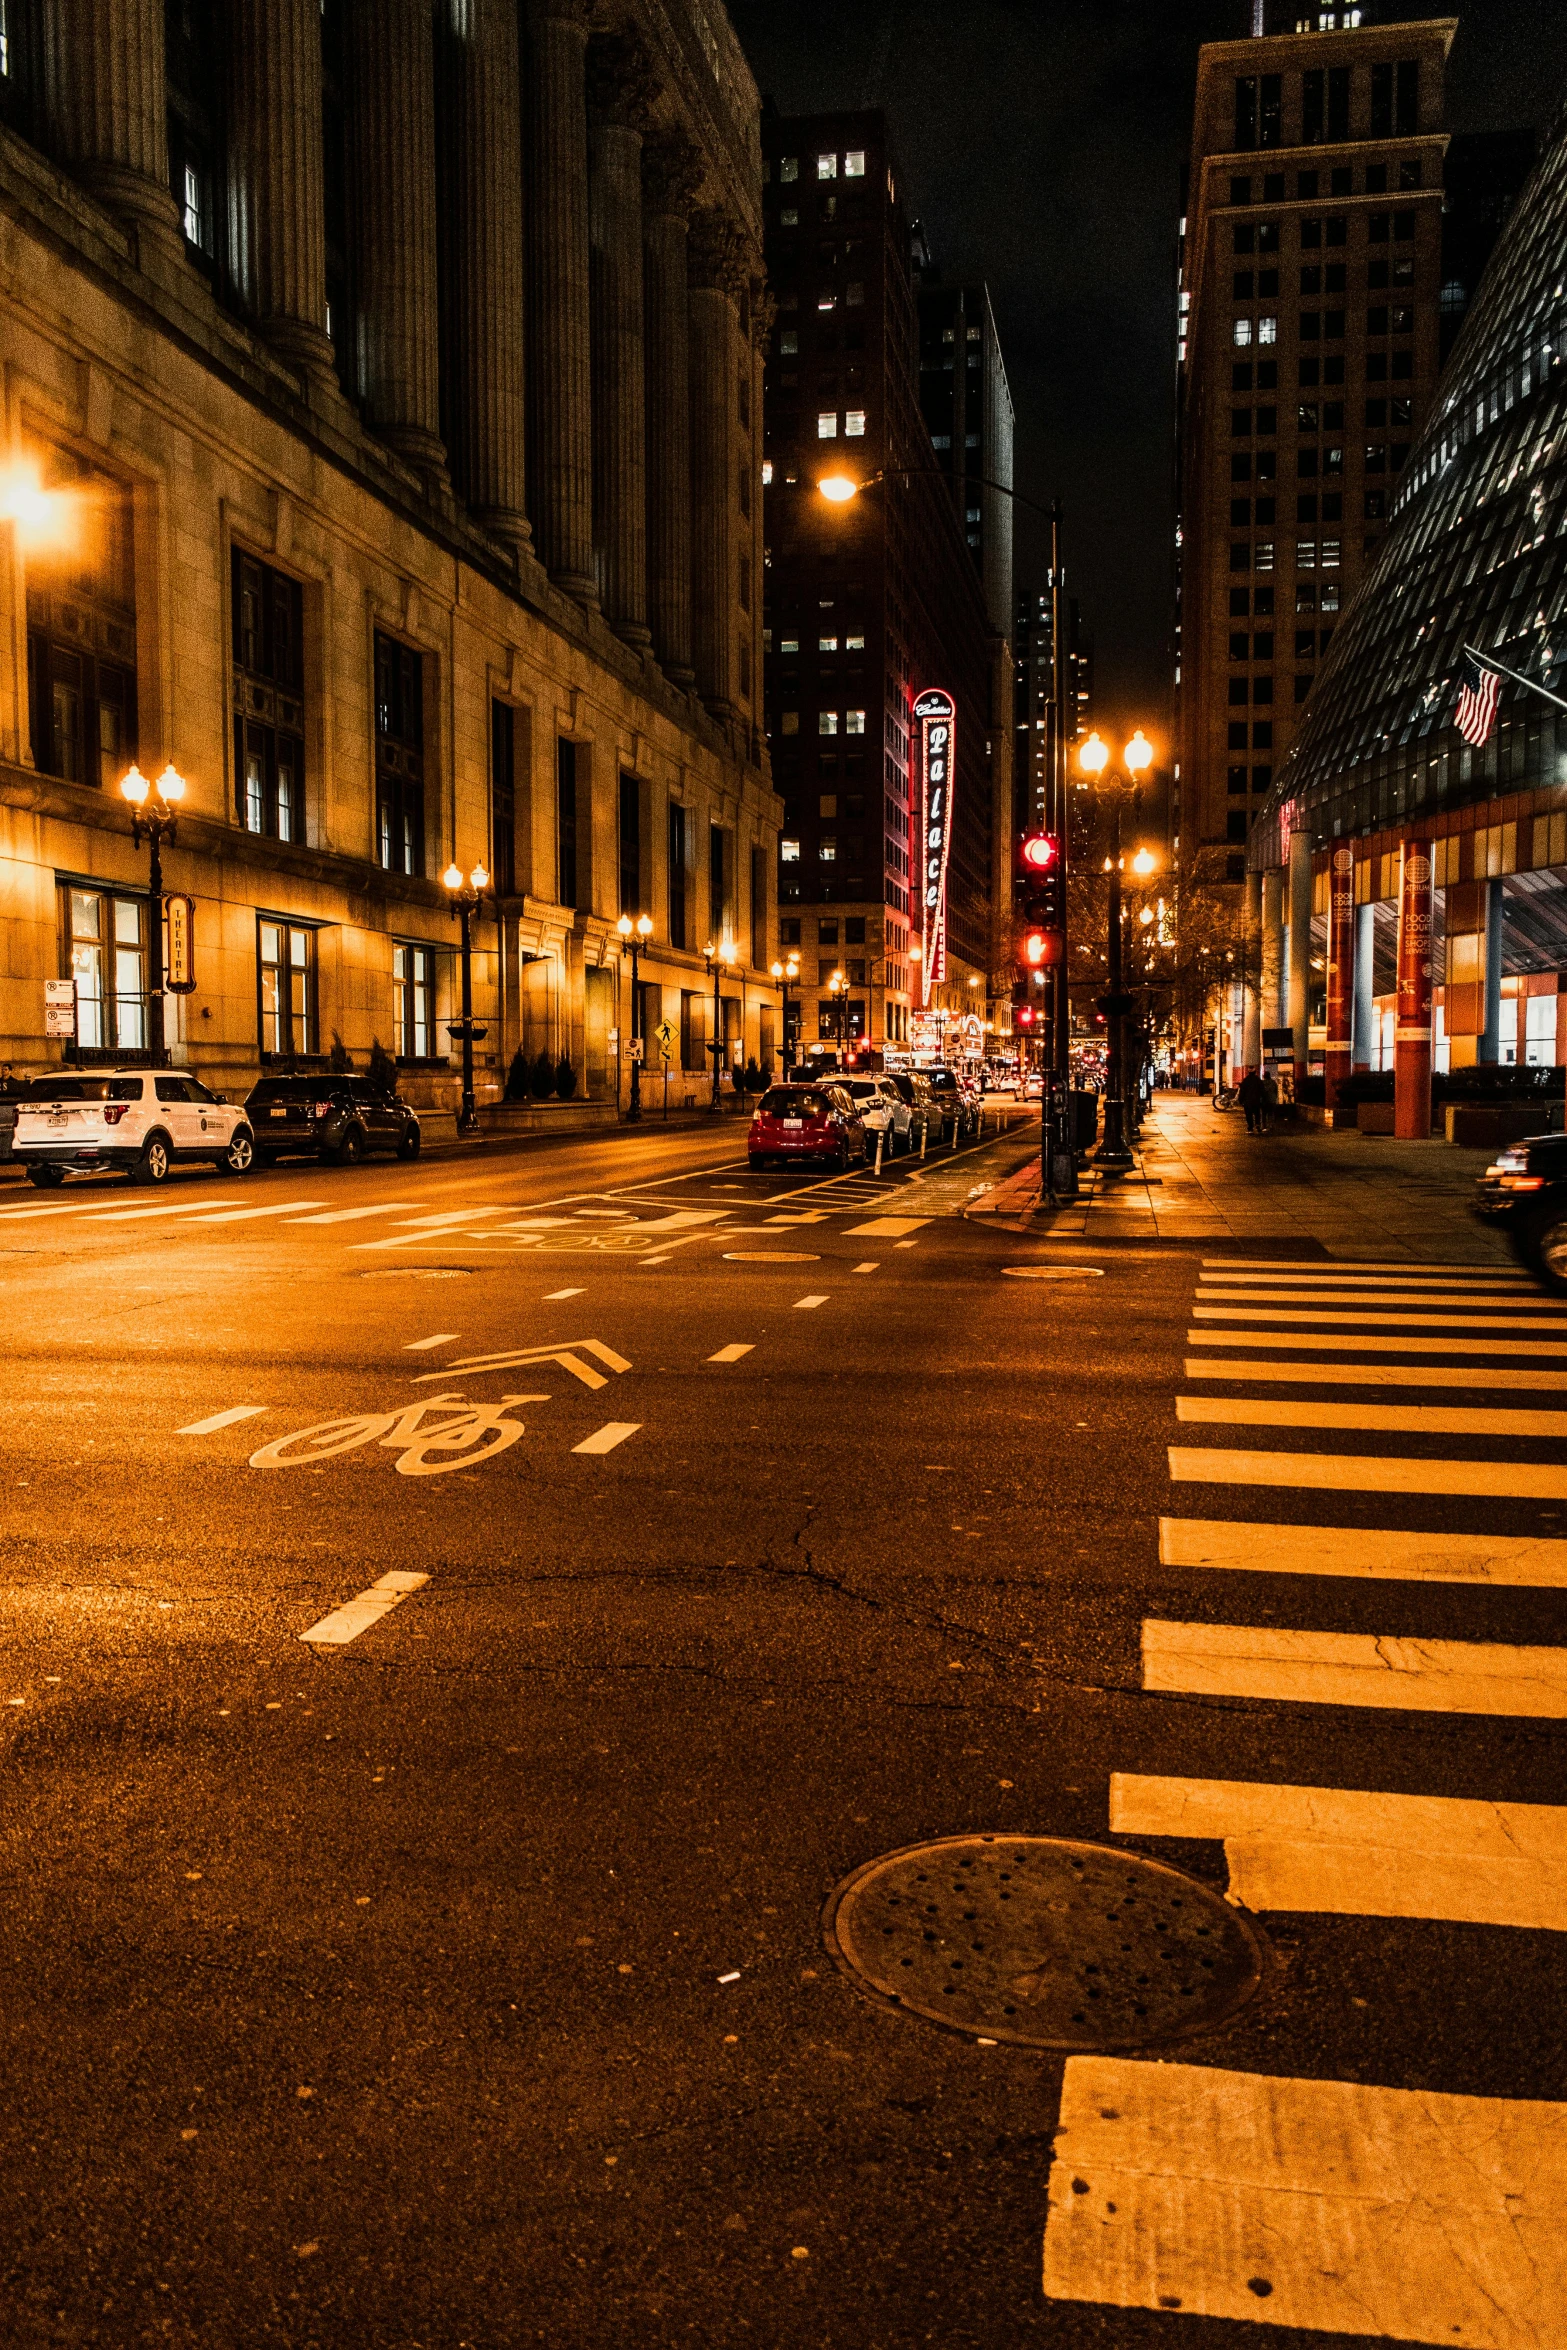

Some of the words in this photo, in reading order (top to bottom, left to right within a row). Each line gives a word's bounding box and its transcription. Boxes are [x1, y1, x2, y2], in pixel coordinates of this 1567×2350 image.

[926, 726, 948, 907] Palace
[1333, 892, 1353, 900] FOOD
[1405, 914, 1432, 923] FOOD
[1405, 923, 1432, 932] COURT
[1405, 939, 1431, 948] SHOPS
